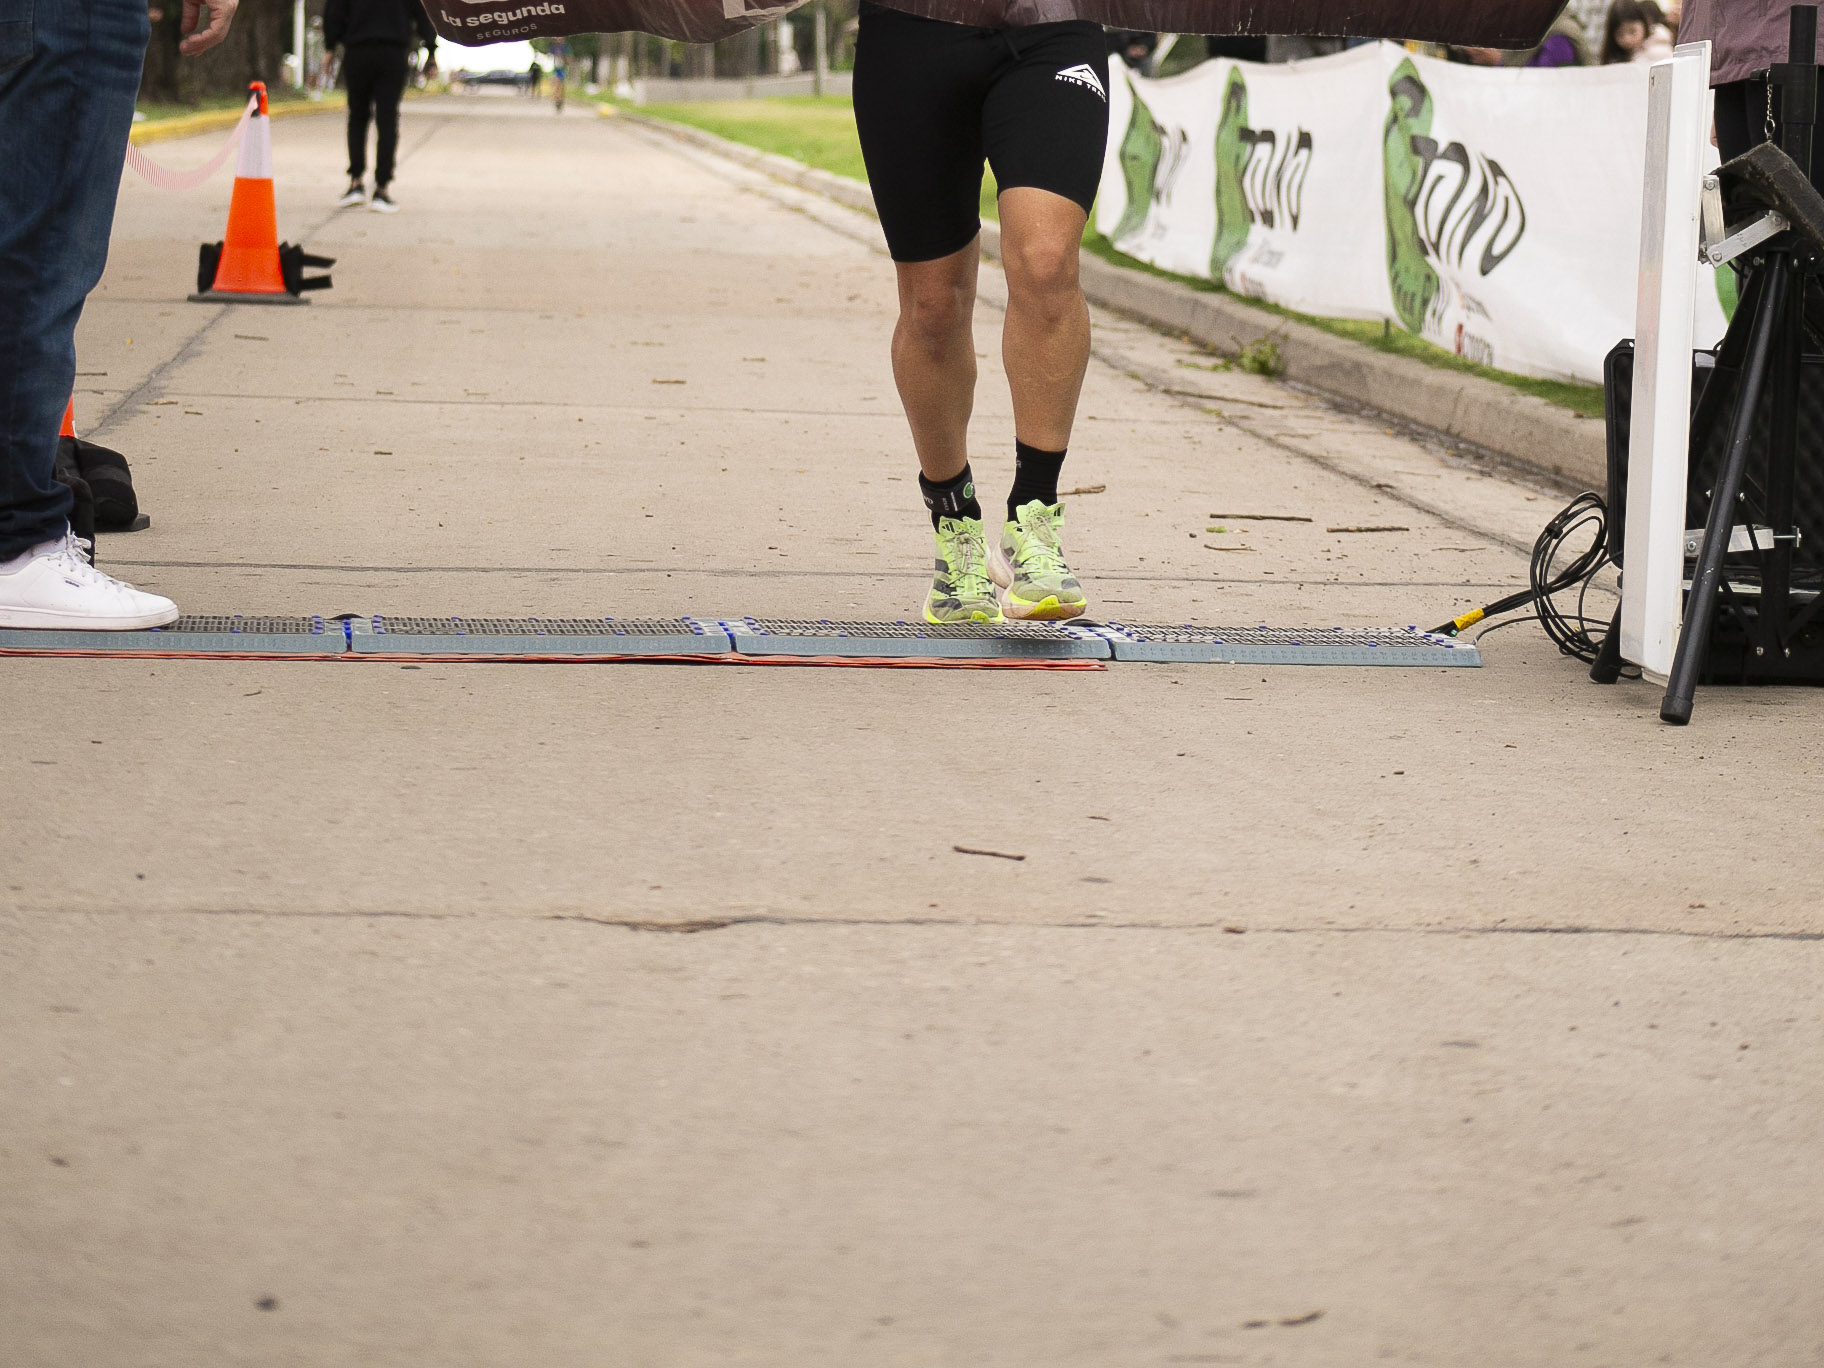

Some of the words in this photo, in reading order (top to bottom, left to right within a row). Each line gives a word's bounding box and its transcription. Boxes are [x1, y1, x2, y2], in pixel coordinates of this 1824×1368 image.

[440, 9, 462, 27] la
[466, 2, 566, 27] segunda
[476, 23, 538, 40] SEGUROS
[1055, 74, 1083, 86] NIKE
